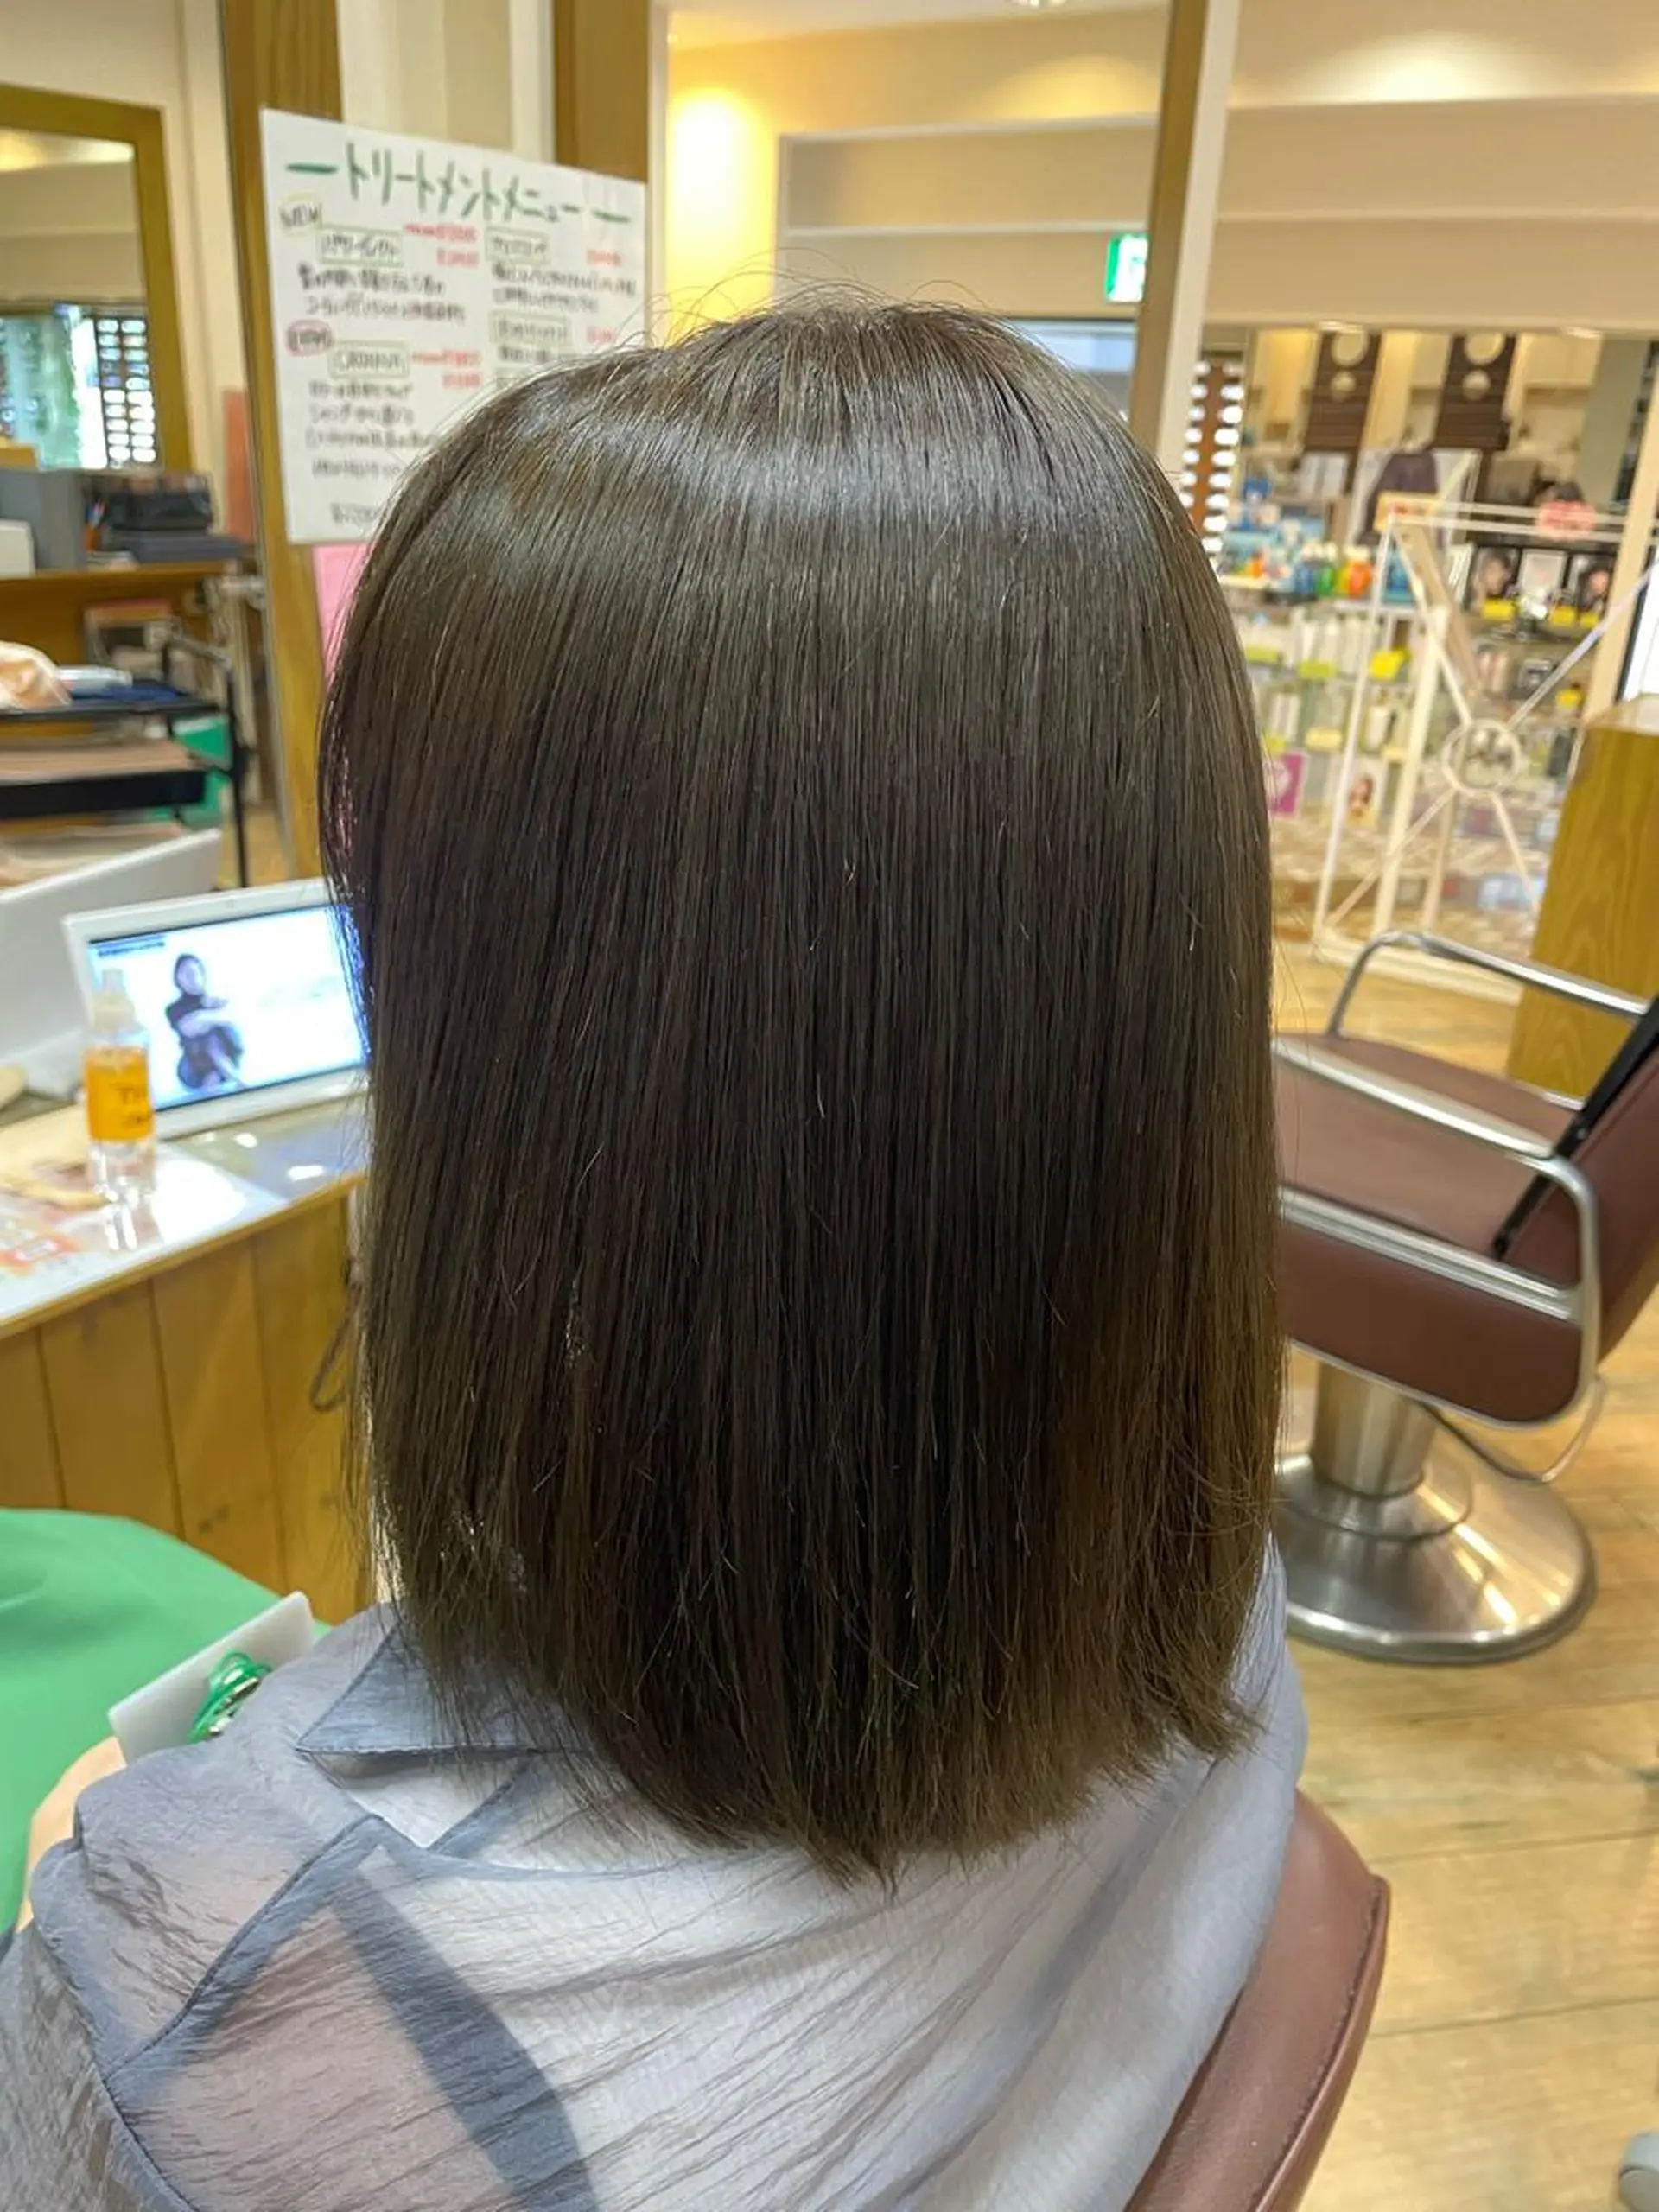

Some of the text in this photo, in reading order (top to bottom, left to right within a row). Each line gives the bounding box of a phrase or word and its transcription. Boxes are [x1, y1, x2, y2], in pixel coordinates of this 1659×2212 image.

[346, 141, 581, 222] トリートメントメニュー
